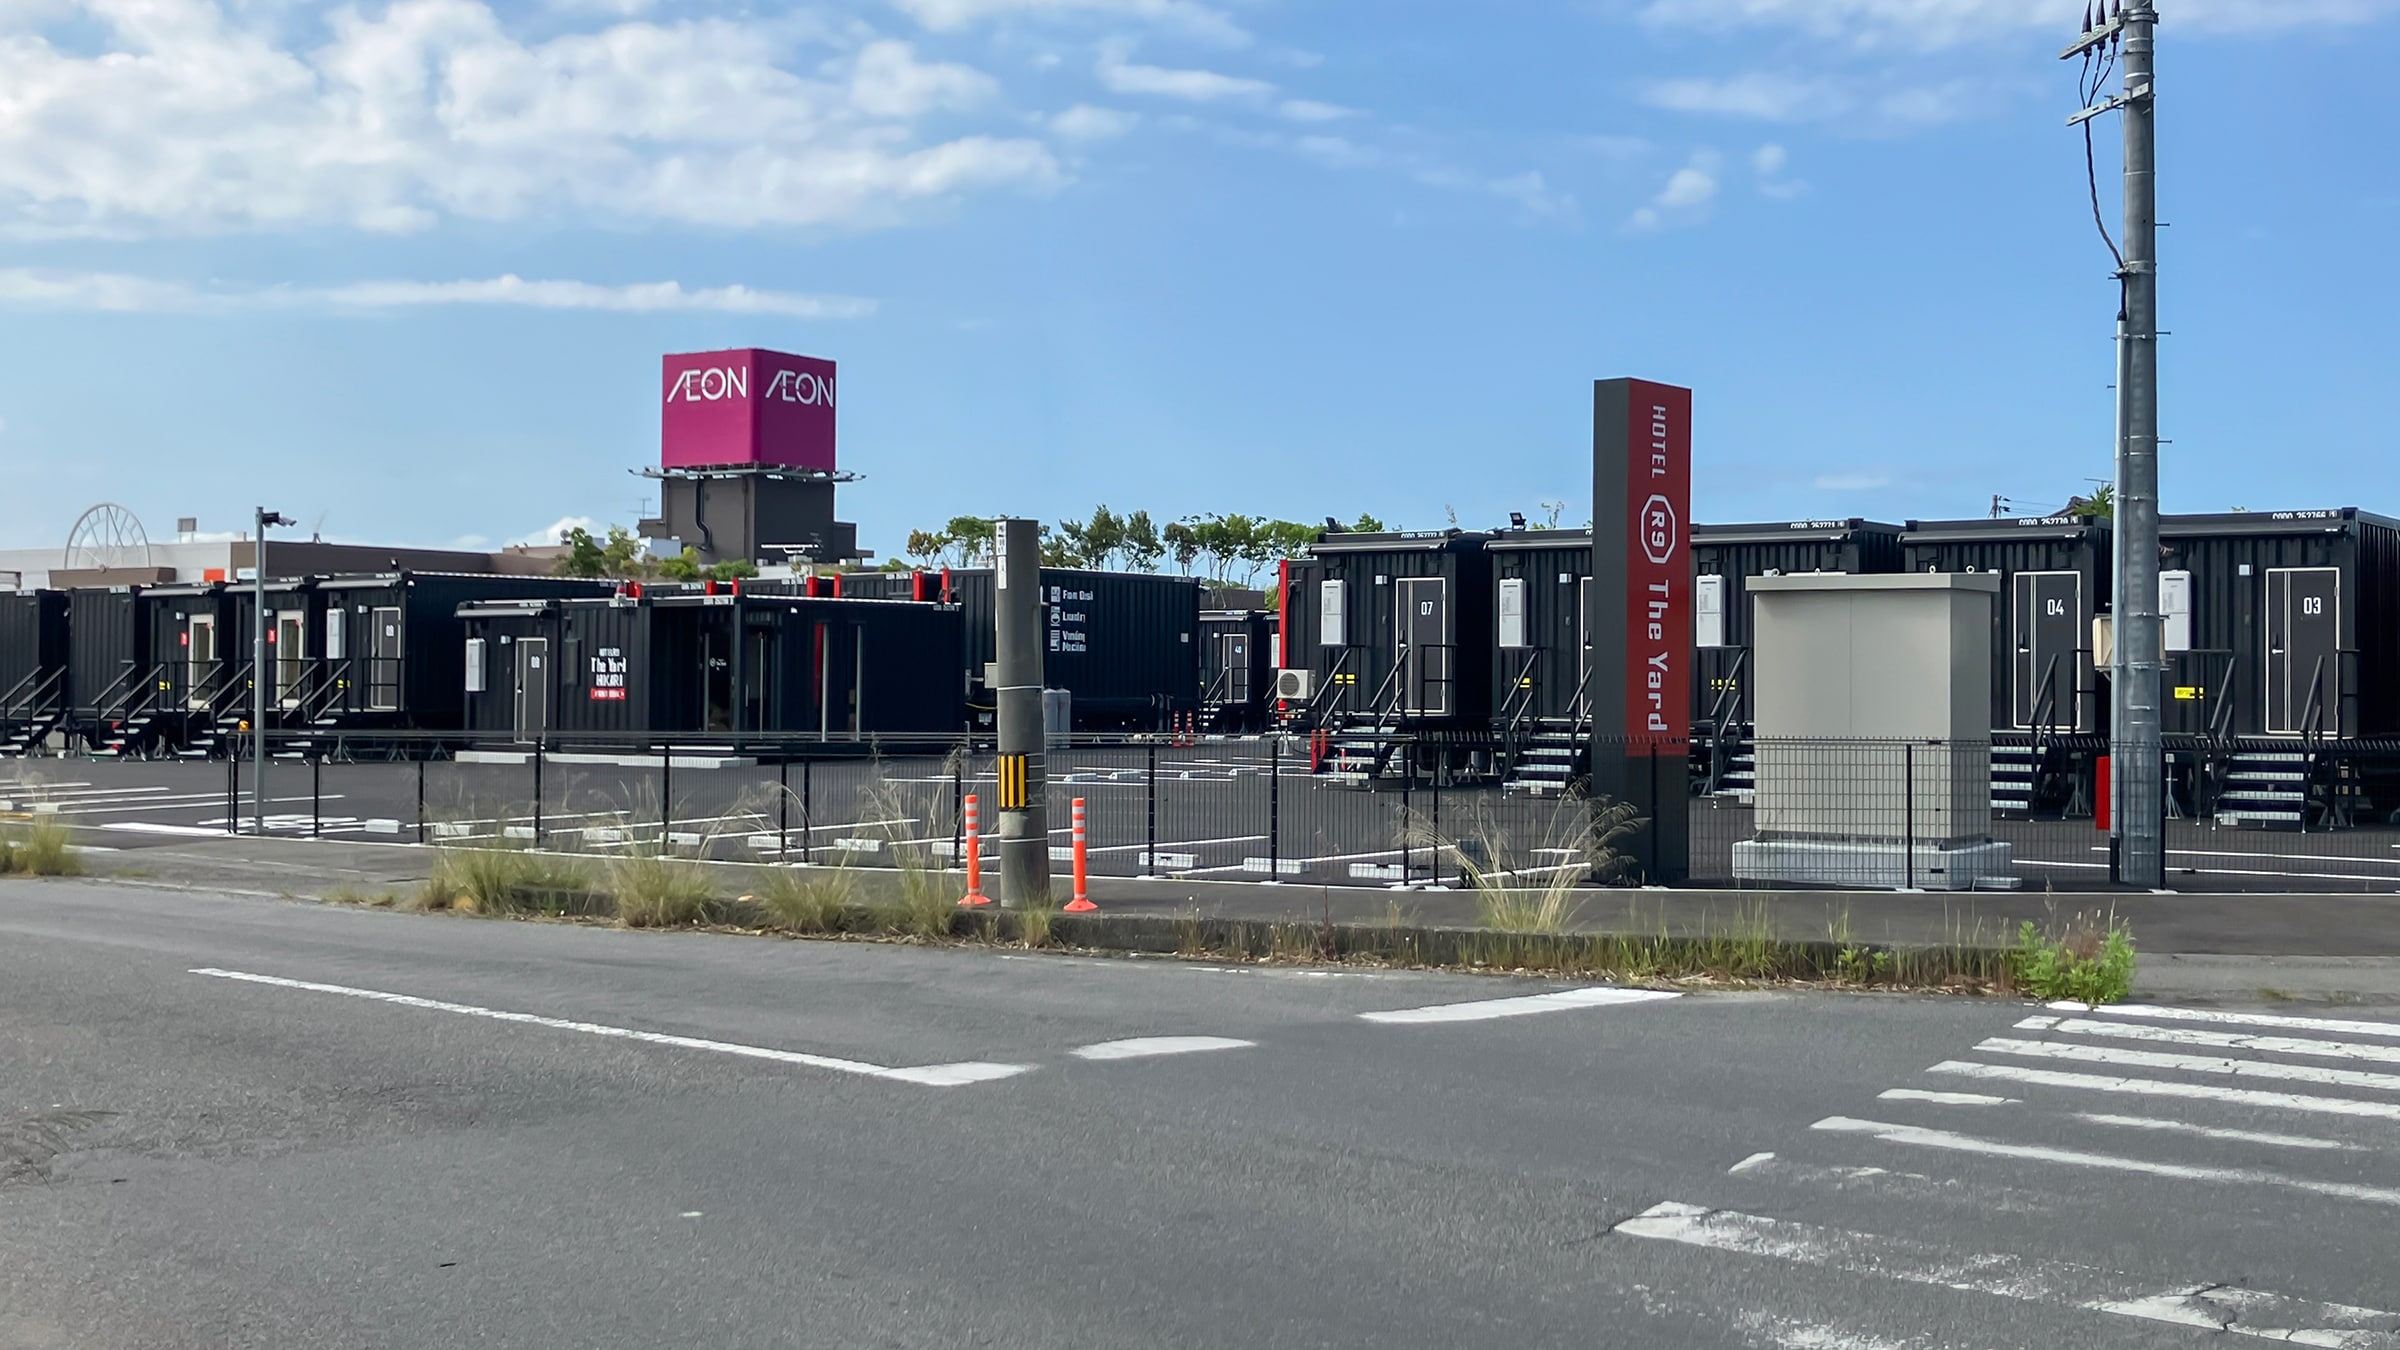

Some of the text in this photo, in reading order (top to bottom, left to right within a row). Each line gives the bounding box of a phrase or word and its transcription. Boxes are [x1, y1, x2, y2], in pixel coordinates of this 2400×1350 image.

[1648, 405, 1669, 731] HOTEL R9 The Yard
[1421, 601, 1433, 615] 07
[2047, 599, 2064, 615] 04
[2303, 597, 2321, 614] 03
